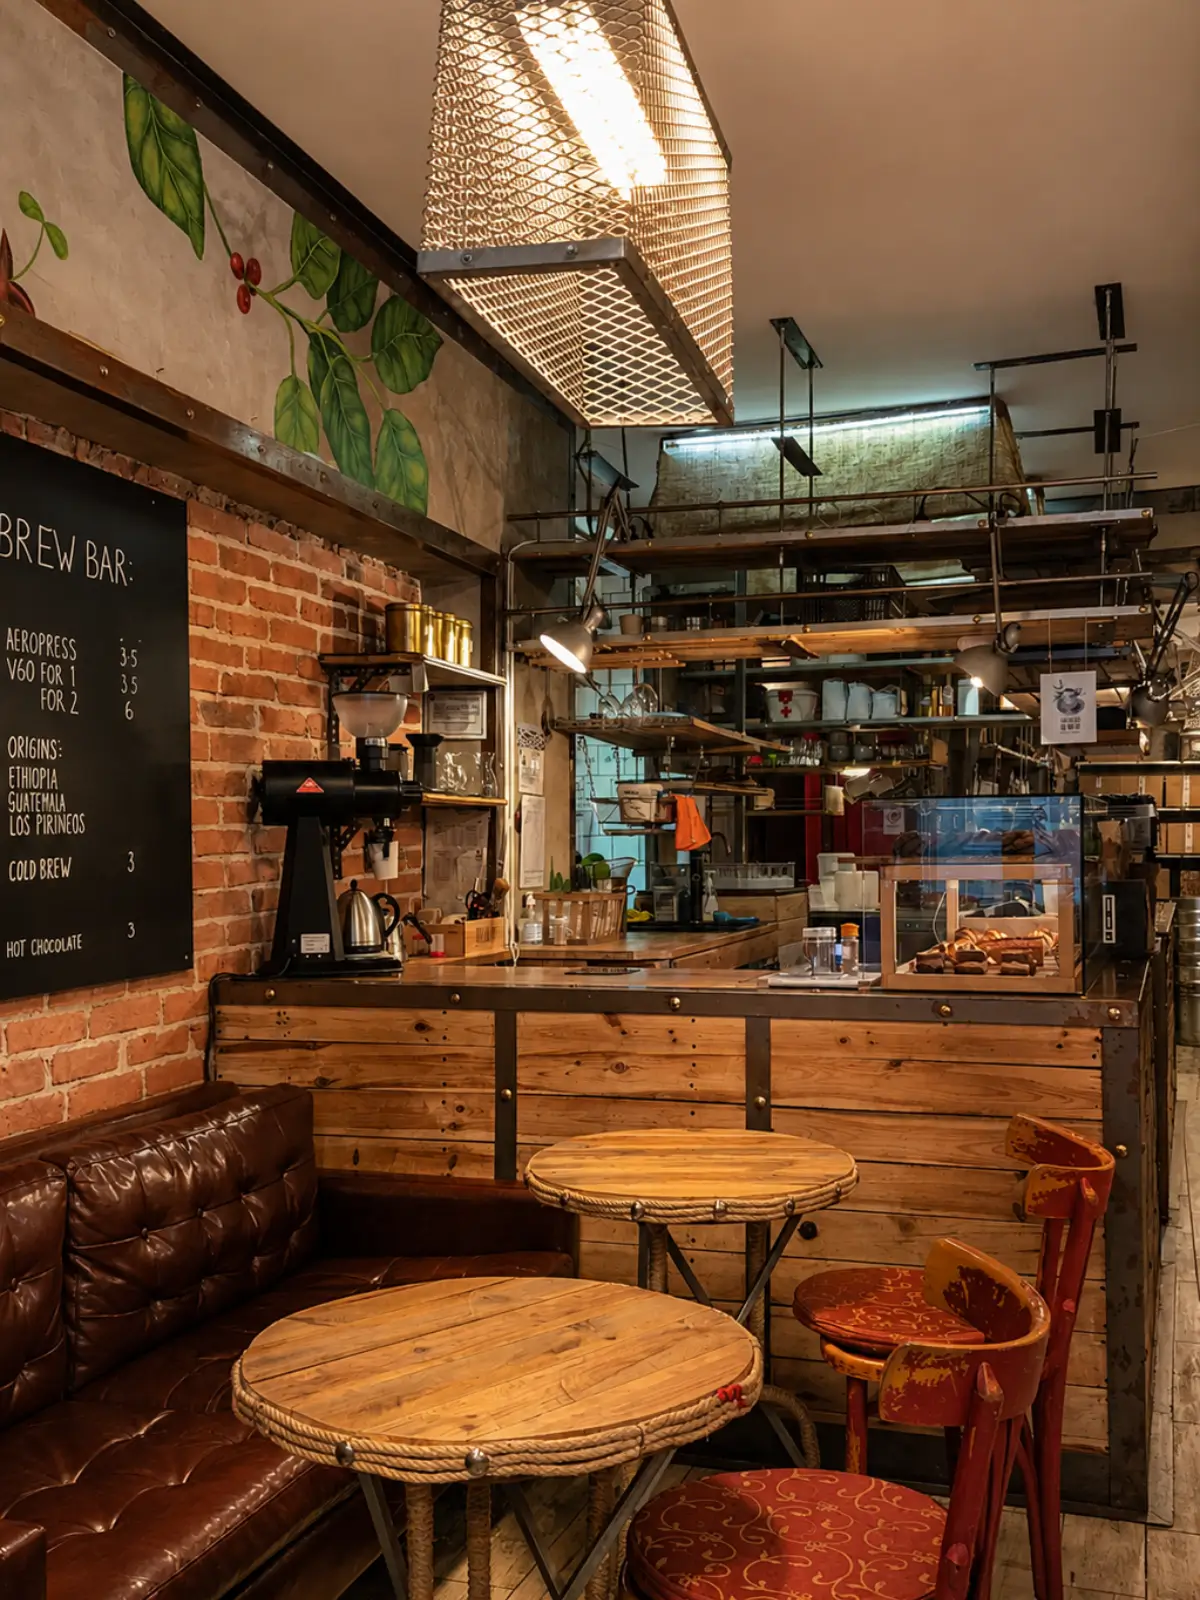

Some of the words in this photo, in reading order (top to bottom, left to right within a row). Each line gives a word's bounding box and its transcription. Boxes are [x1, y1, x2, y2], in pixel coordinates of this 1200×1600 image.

[0, 512, 76, 573] BREW
[86, 540, 134, 587] BAR:
[6, 627, 77, 661] AEROPRESS
[6, 657, 35, 682] V60
[41, 661, 64, 686] FOR
[70, 665, 76, 687] 1
[41, 688, 66, 713] FOR
[70, 691, 79, 715] 2
[125, 700, 134, 720] 6
[7, 735, 62, 760] ORIGINS:
[9, 766, 58, 790] ETHIOPIA
[8, 791, 66, 813] GUATEMALA
[10, 814, 31, 837] LOS
[36, 813, 86, 836] PIRINEOS
[9, 859, 37, 882] COLD
[39, 857, 72, 880] BREW
[127, 851, 135, 873] 3
[7, 939, 27, 958] HOT
[31, 933, 83, 956] CHOCOLATE
[127, 922, 136, 939] 3
